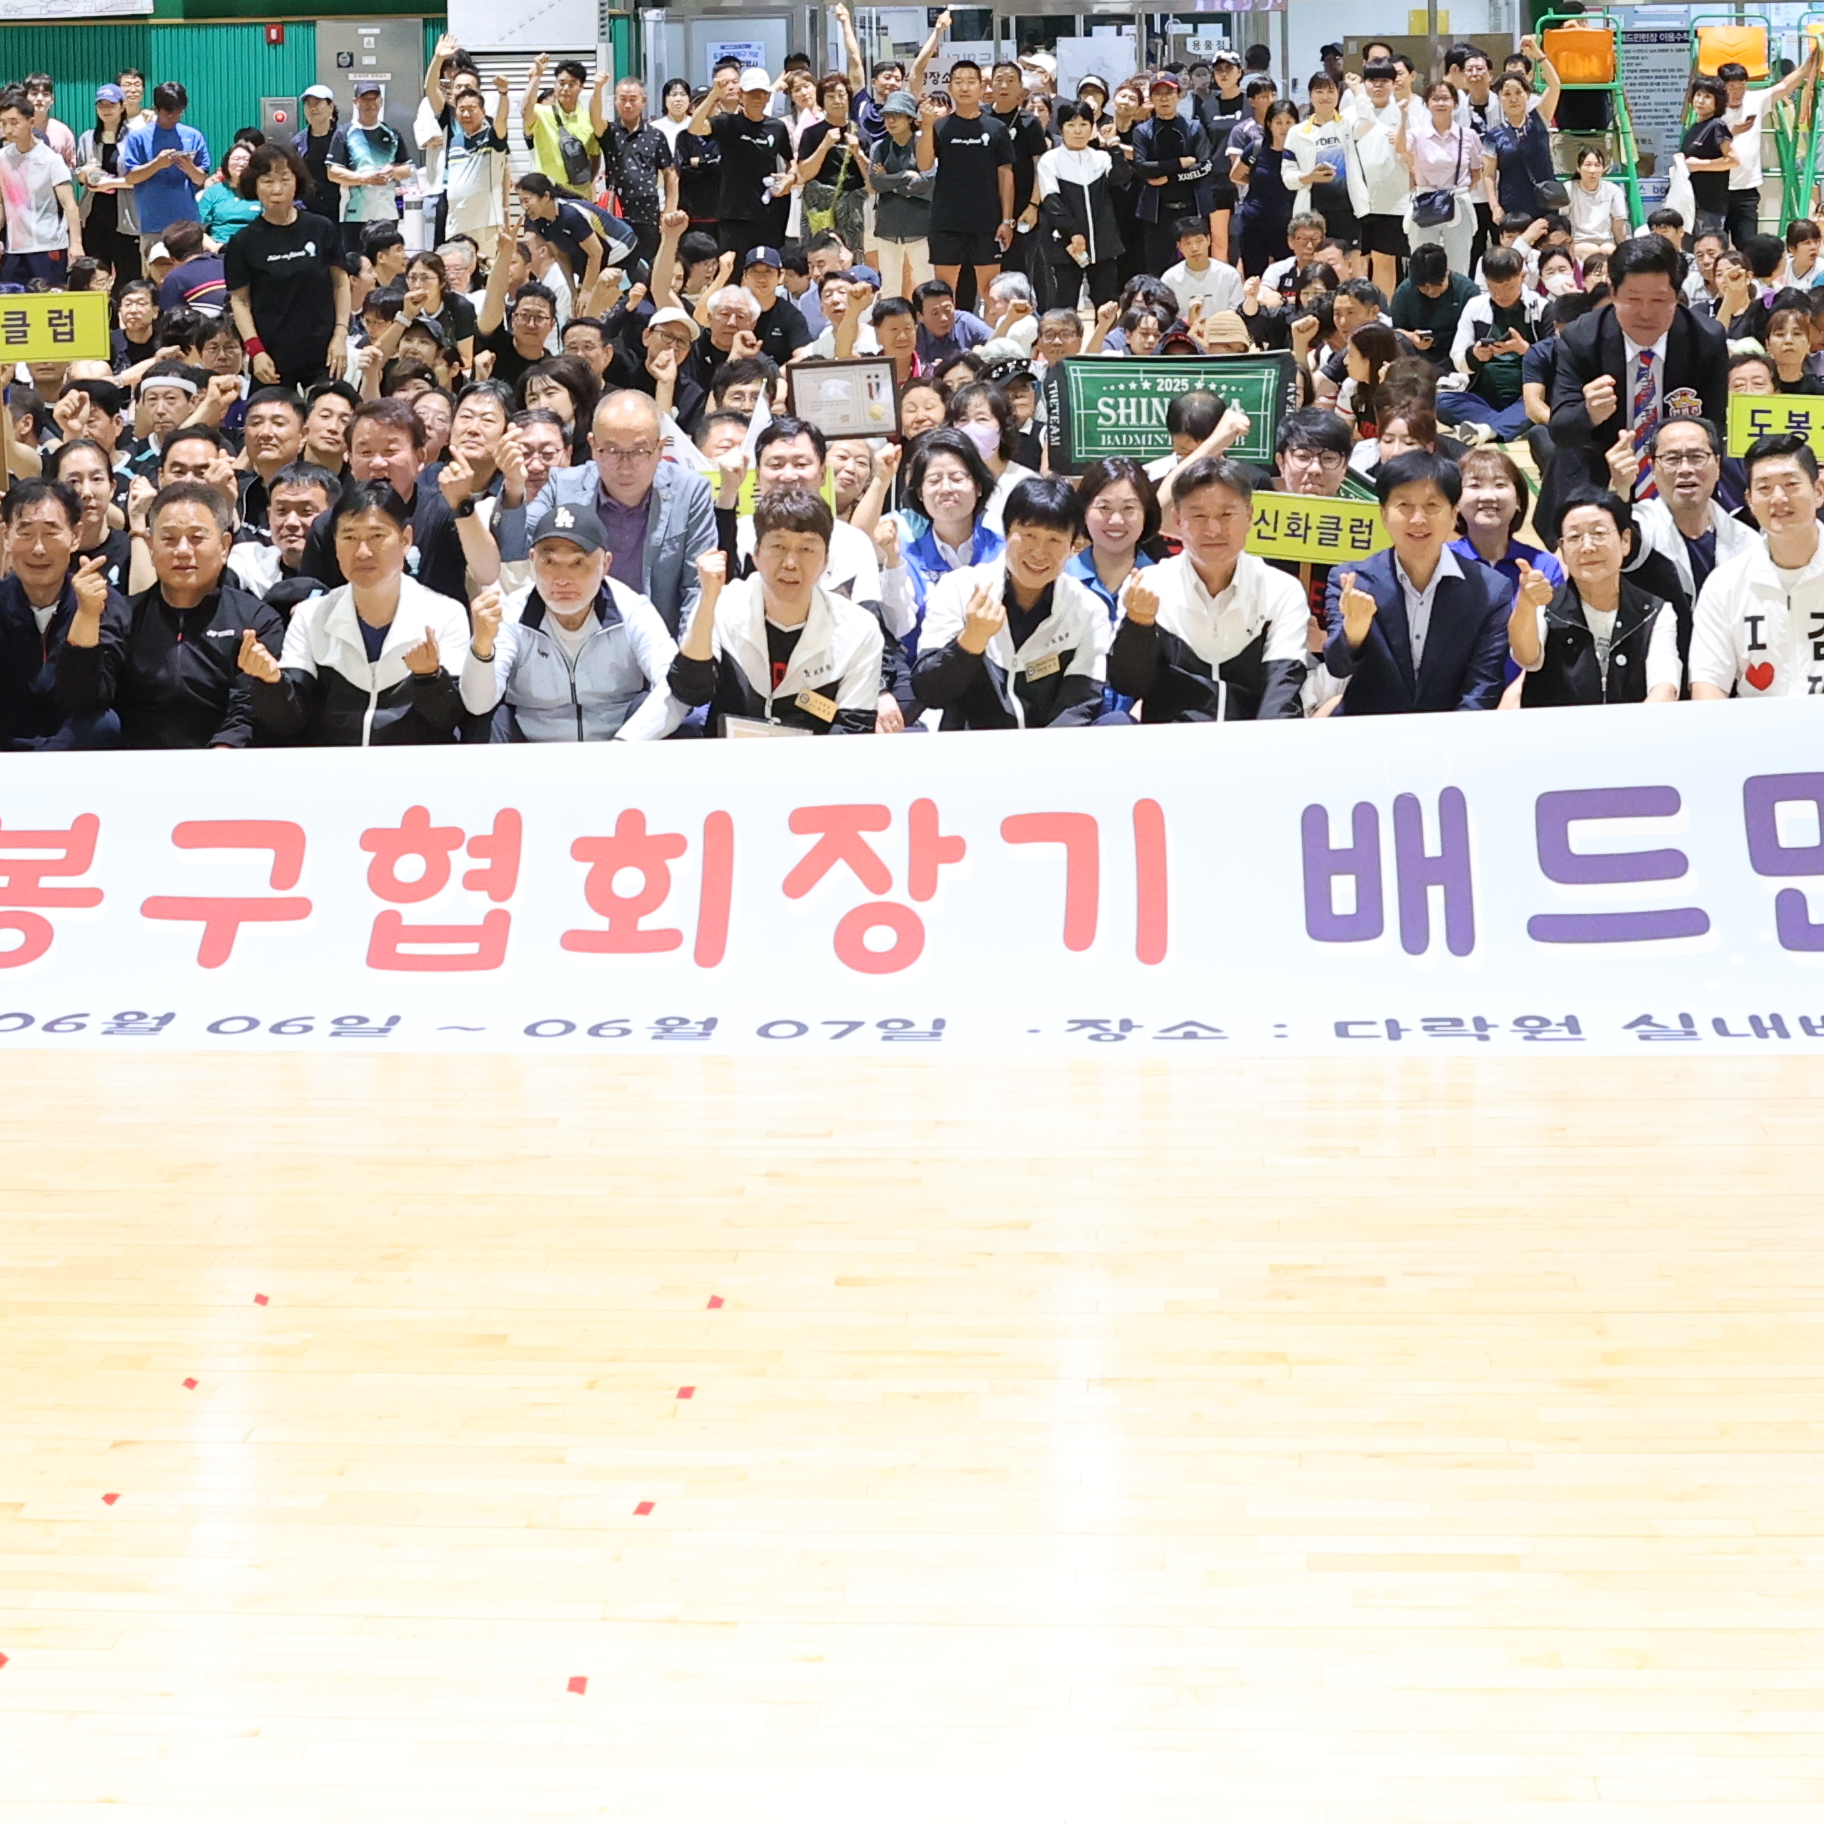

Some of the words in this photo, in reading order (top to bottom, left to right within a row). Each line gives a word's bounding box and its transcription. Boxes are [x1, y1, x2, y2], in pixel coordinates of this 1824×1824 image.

[1622, 32, 1658, 43] 드민턴장
[1156, 378, 1189, 393] 2025
[1254, 509, 1375, 551] 신화클럽
[205, 1014, 402, 1038] 06일
[522, 1016, 720, 1041] 06월
[755, 1017, 947, 1042] 07일
[1333, 1015, 1587, 1042] 다락원
